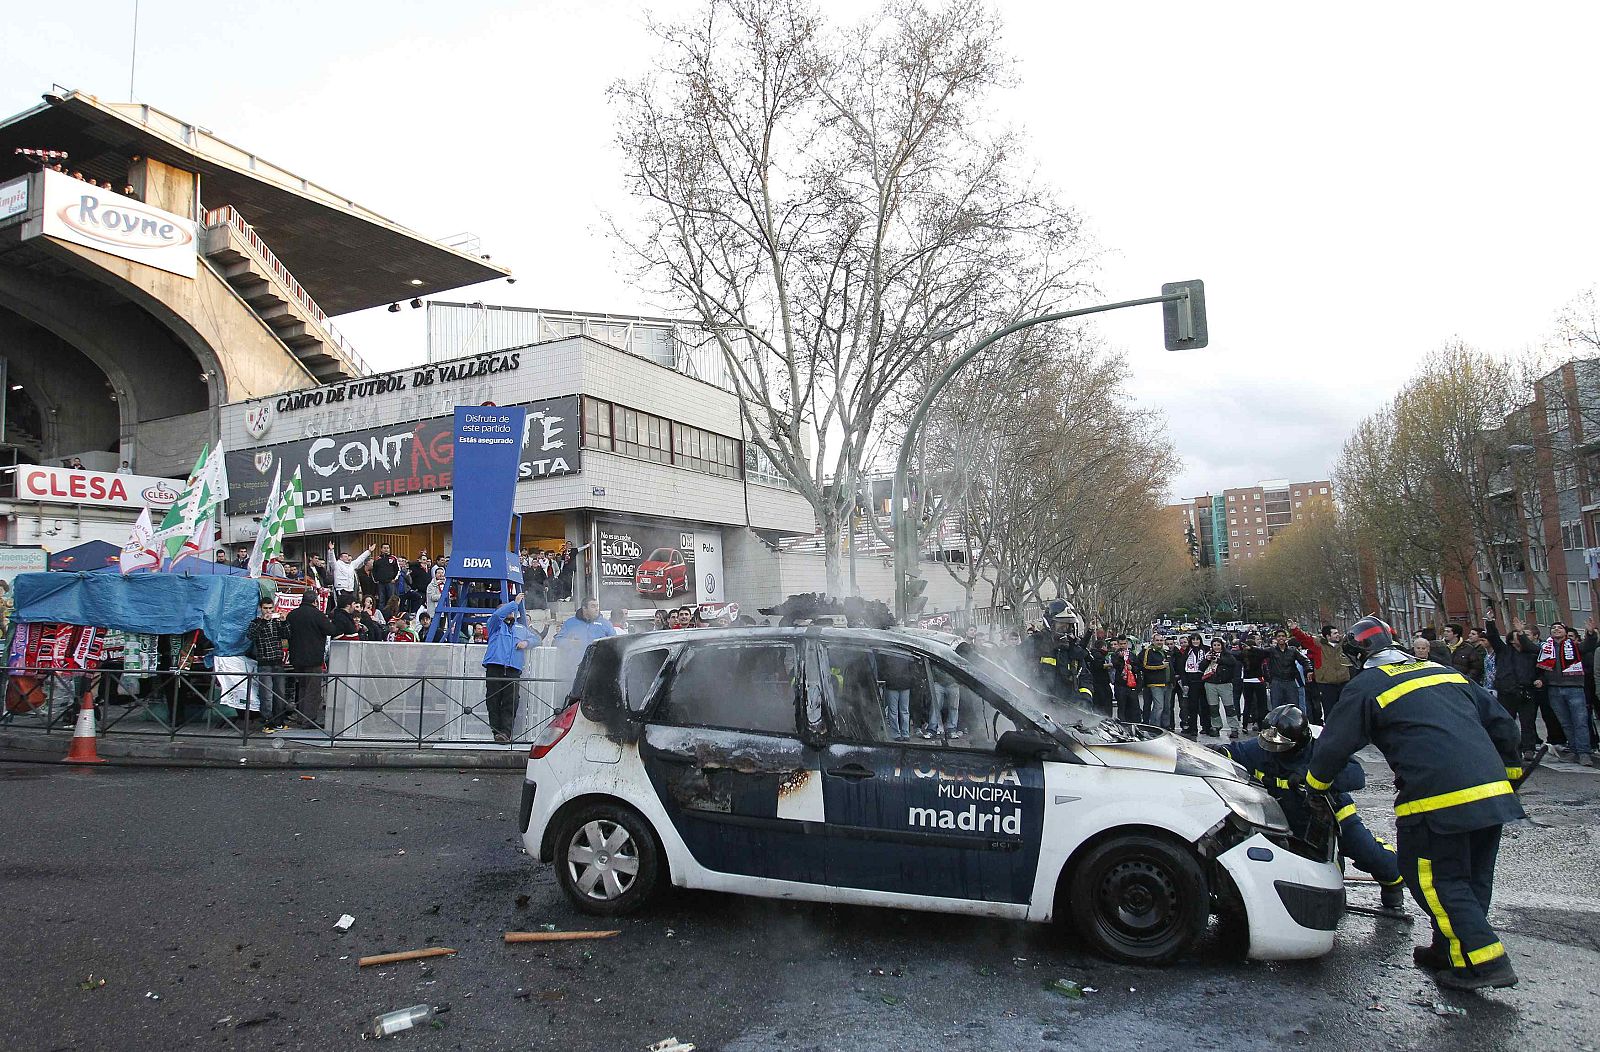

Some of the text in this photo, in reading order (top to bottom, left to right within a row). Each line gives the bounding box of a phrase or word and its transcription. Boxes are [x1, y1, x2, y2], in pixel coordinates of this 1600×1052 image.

[79, 195, 174, 240] Royne
[276, 353, 521, 413] CAMPO DE FUTBOL DE VALLECAS
[465, 413, 510, 424] Disfruta de
[462, 424, 511, 435] este partido
[459, 436, 514, 445] Estás asegurado
[27, 471, 128, 501] CLESA
[306, 487, 333, 503] DE
[339, 484, 367, 500] LA
[373, 472, 451, 496] FIEBRE
[147, 491, 175, 500] CLESA
[600, 531, 608, 539] No
[601, 540, 640, 557] Es tu Polo
[702, 543, 714, 553] Polo
[463, 557, 492, 569] BBVA
[938, 783, 1022, 804] MUNICIPAL
[908, 804, 1022, 835] madrid
